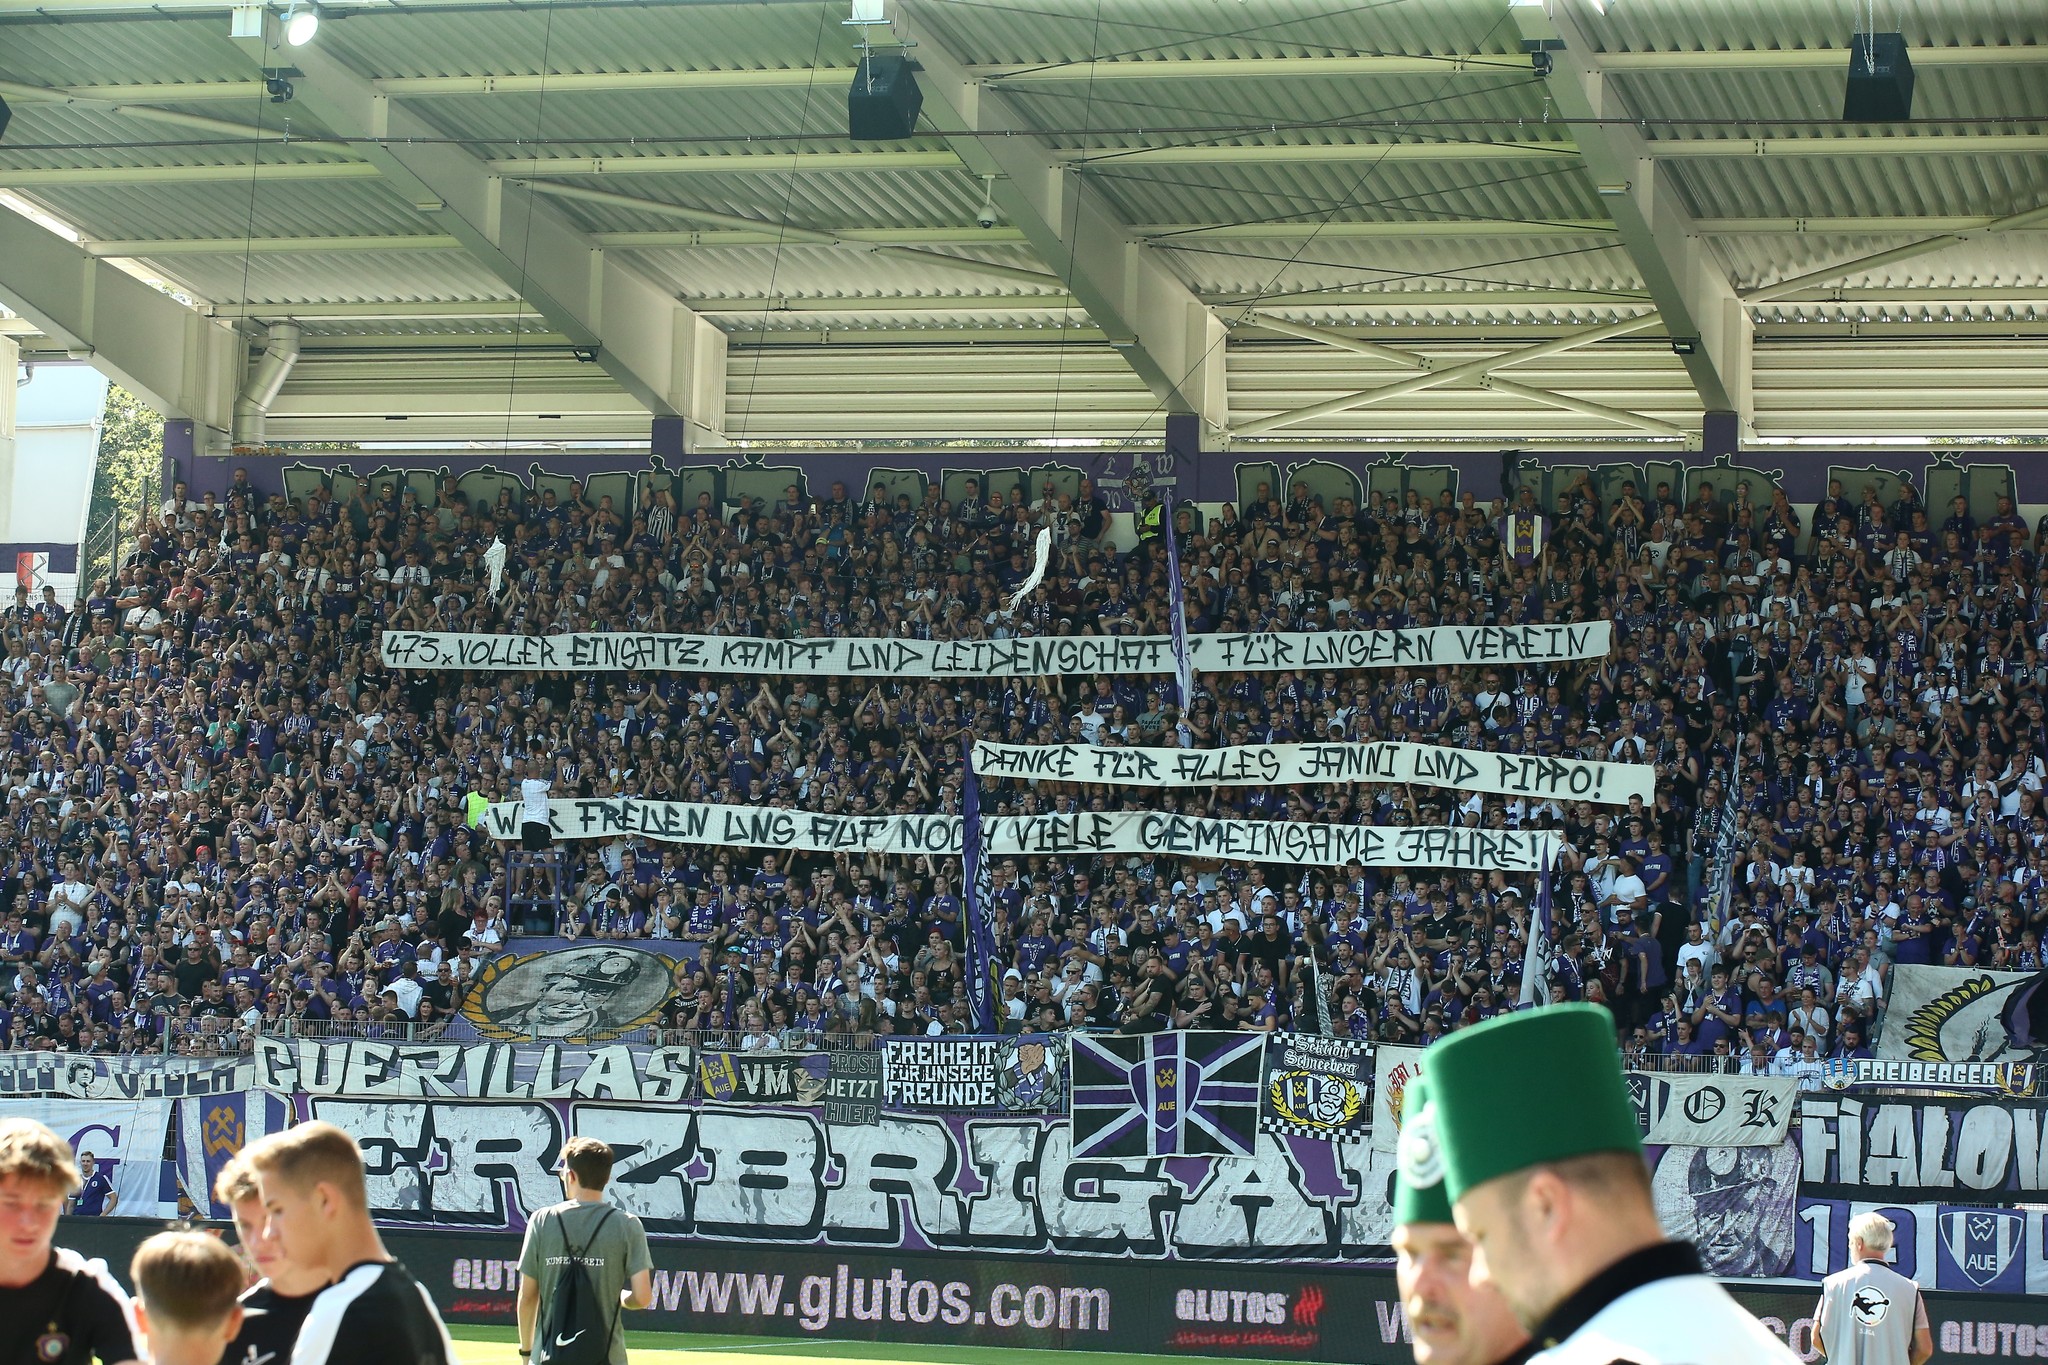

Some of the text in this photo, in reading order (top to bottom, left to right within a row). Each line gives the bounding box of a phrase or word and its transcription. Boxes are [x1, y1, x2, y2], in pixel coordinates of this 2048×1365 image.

[1515, 545, 1531, 553] AUE
[458, 636, 557, 667] VOLLER
[721, 640, 834, 670] KAMPF
[847, 642, 923, 672] UND
[931, 638, 1202, 675] LEIDENSCHAF
[1217, 635, 1293, 667] FÜR
[1303, 628, 1433, 666] UNSERN
[1456, 626, 1590, 660] VEREIN
[979, 743, 1604, 799] DANKE FÜR ALLES JANNI UND PIPPO!
[492, 805, 563, 835] WR
[577, 802, 708, 837] FREUEN
[723, 811, 796, 845] UNS
[809, 818, 889, 848] AUF
[1015, 814, 1116, 851] VIELE
[1140, 815, 1385, 862] GEMEINSAME
[1397, 829, 1538, 869] JAHRE!
[886, 1041, 997, 1065] FREIHEIT
[1295, 1036, 1350, 1059] Sektion
[256, 1036, 694, 1101] GUERILLAS
[828, 1053, 880, 1075] PROST
[922, 1065, 995, 1082] UNSERE
[1284, 1050, 1359, 1078] Schneeberg
[1858, 1061, 1998, 1084] FREIBERGER
[714, 1084, 731, 1095] AUE
[740, 1061, 793, 1096] VM
[826, 1079, 878, 1098] JETZT
[886, 1081, 996, 1105] FREUNDE
[824, 1101, 876, 1125] HIER
[1156, 1101, 1176, 1111] AUE
[1966, 1252, 1998, 1272] AUE
[452, 1258, 518, 1292] GLUT
[648, 1264, 1110, 1331] www.glutos.com
[1175, 1289, 1287, 1325] GLUTOS
